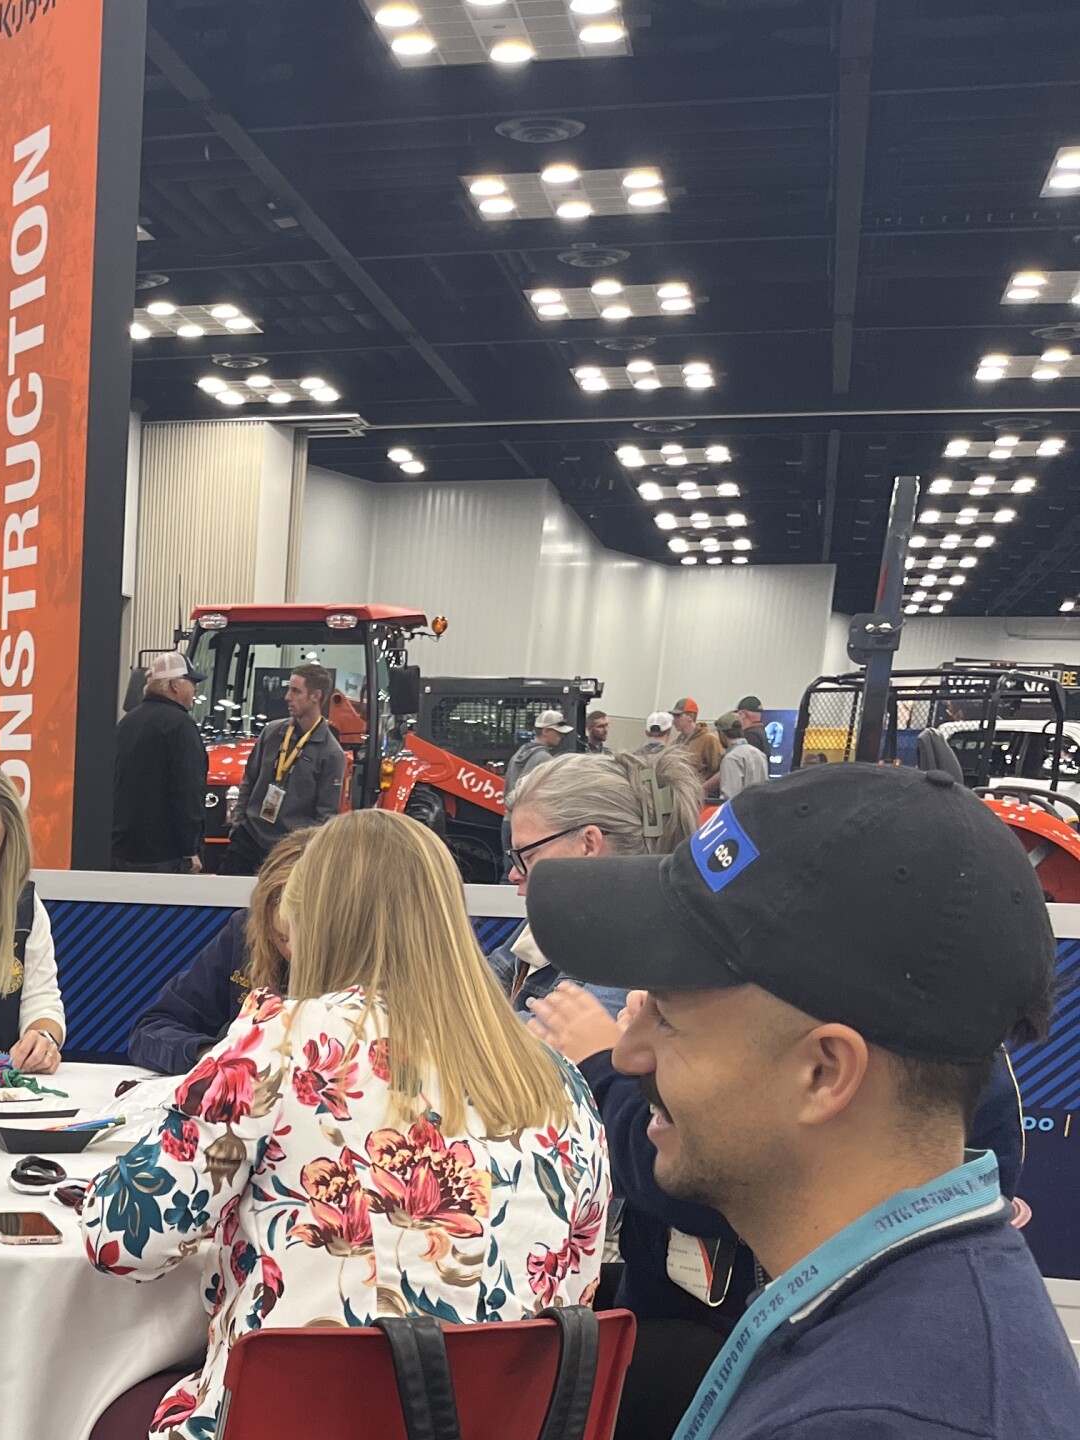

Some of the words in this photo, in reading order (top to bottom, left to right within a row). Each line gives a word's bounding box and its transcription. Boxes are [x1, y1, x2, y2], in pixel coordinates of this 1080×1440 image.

[457, 767, 504, 804] Kubo
[715, 844, 733, 868] abc
[718, 1351, 739, 1382] EXPO
[787, 1264, 819, 1295] 2024
